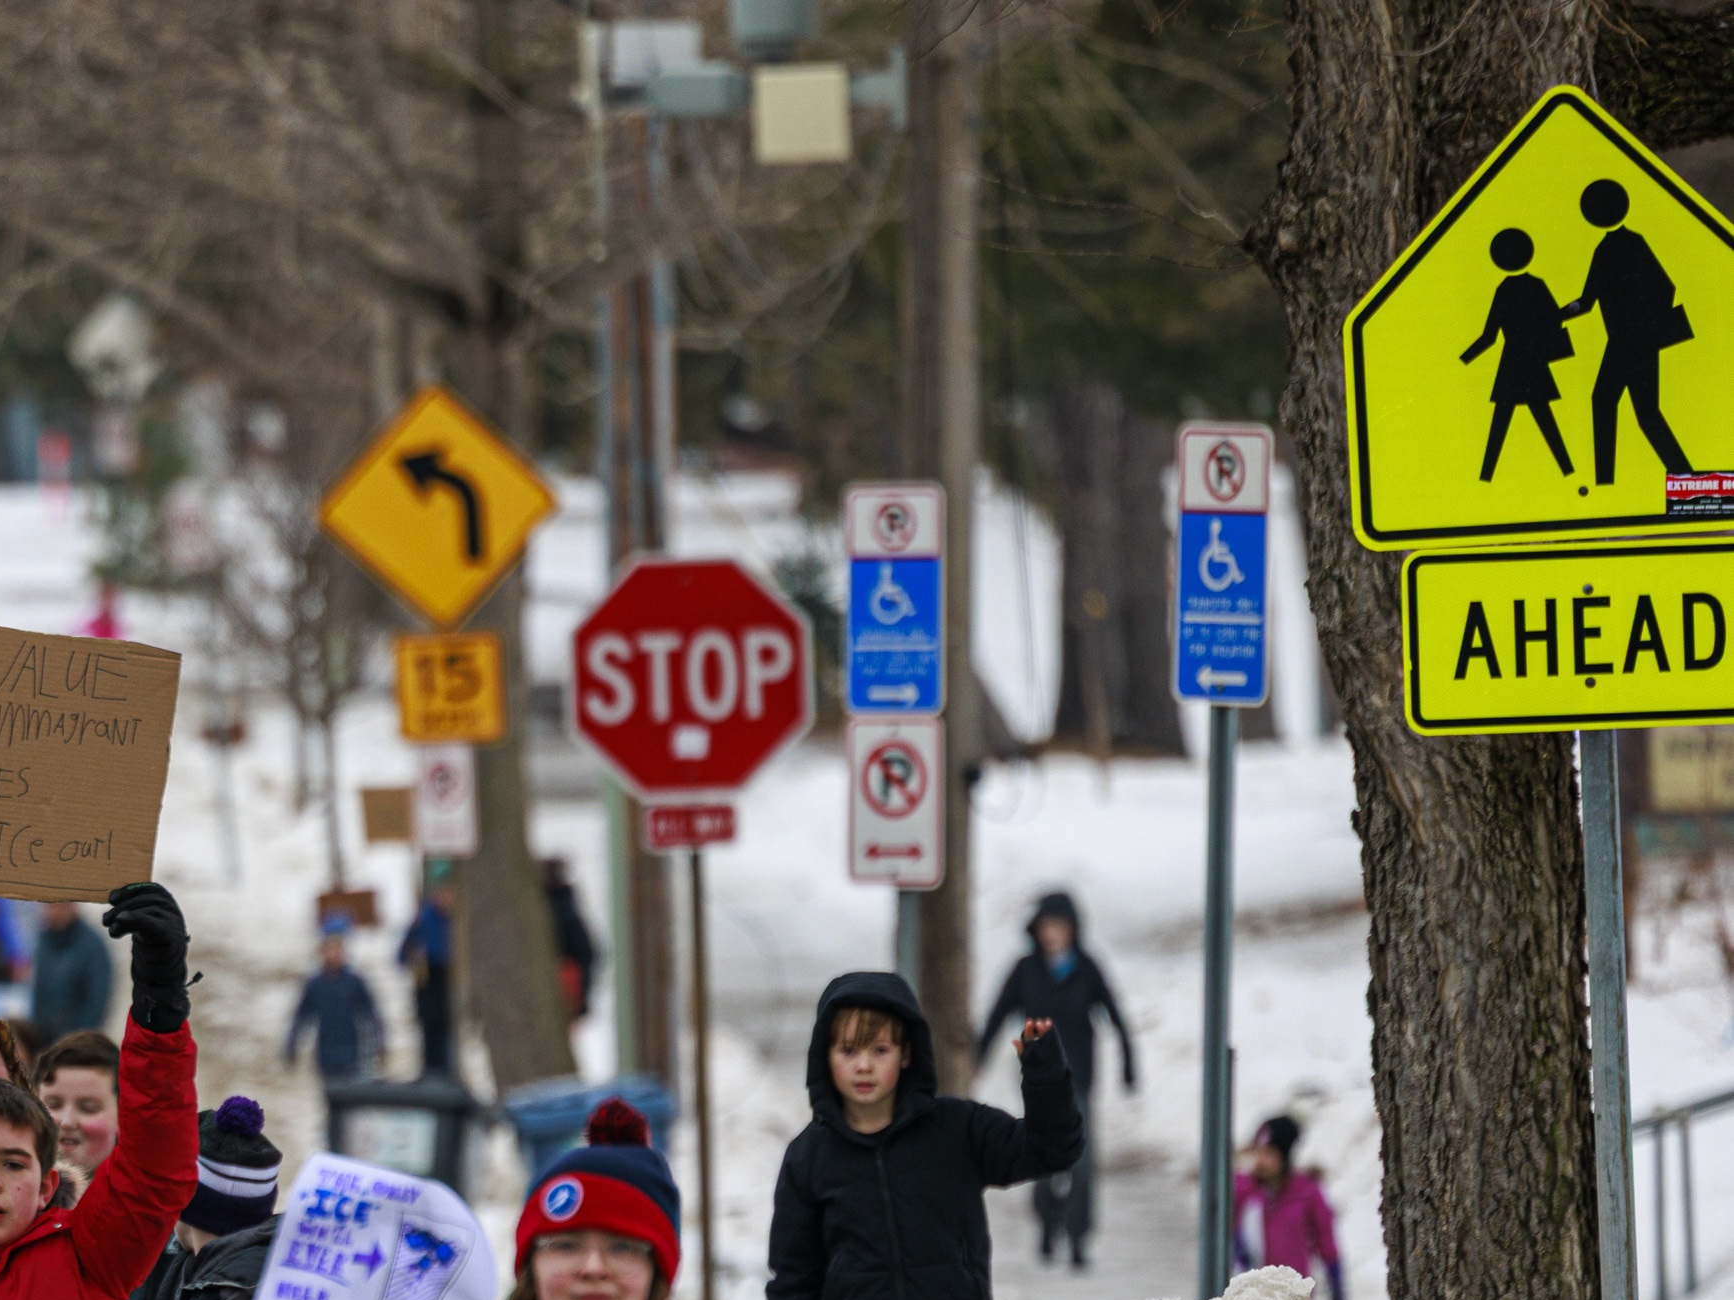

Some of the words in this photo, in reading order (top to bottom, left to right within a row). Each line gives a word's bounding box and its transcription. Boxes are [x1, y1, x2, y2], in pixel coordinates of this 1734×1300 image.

[1666, 480, 1719, 491] EXTREME
[1454, 592, 1726, 680] AHEAD
[417, 654, 483, 702] 15
[585, 628, 793, 727] STOP
[320, 1168, 360, 1192] THE
